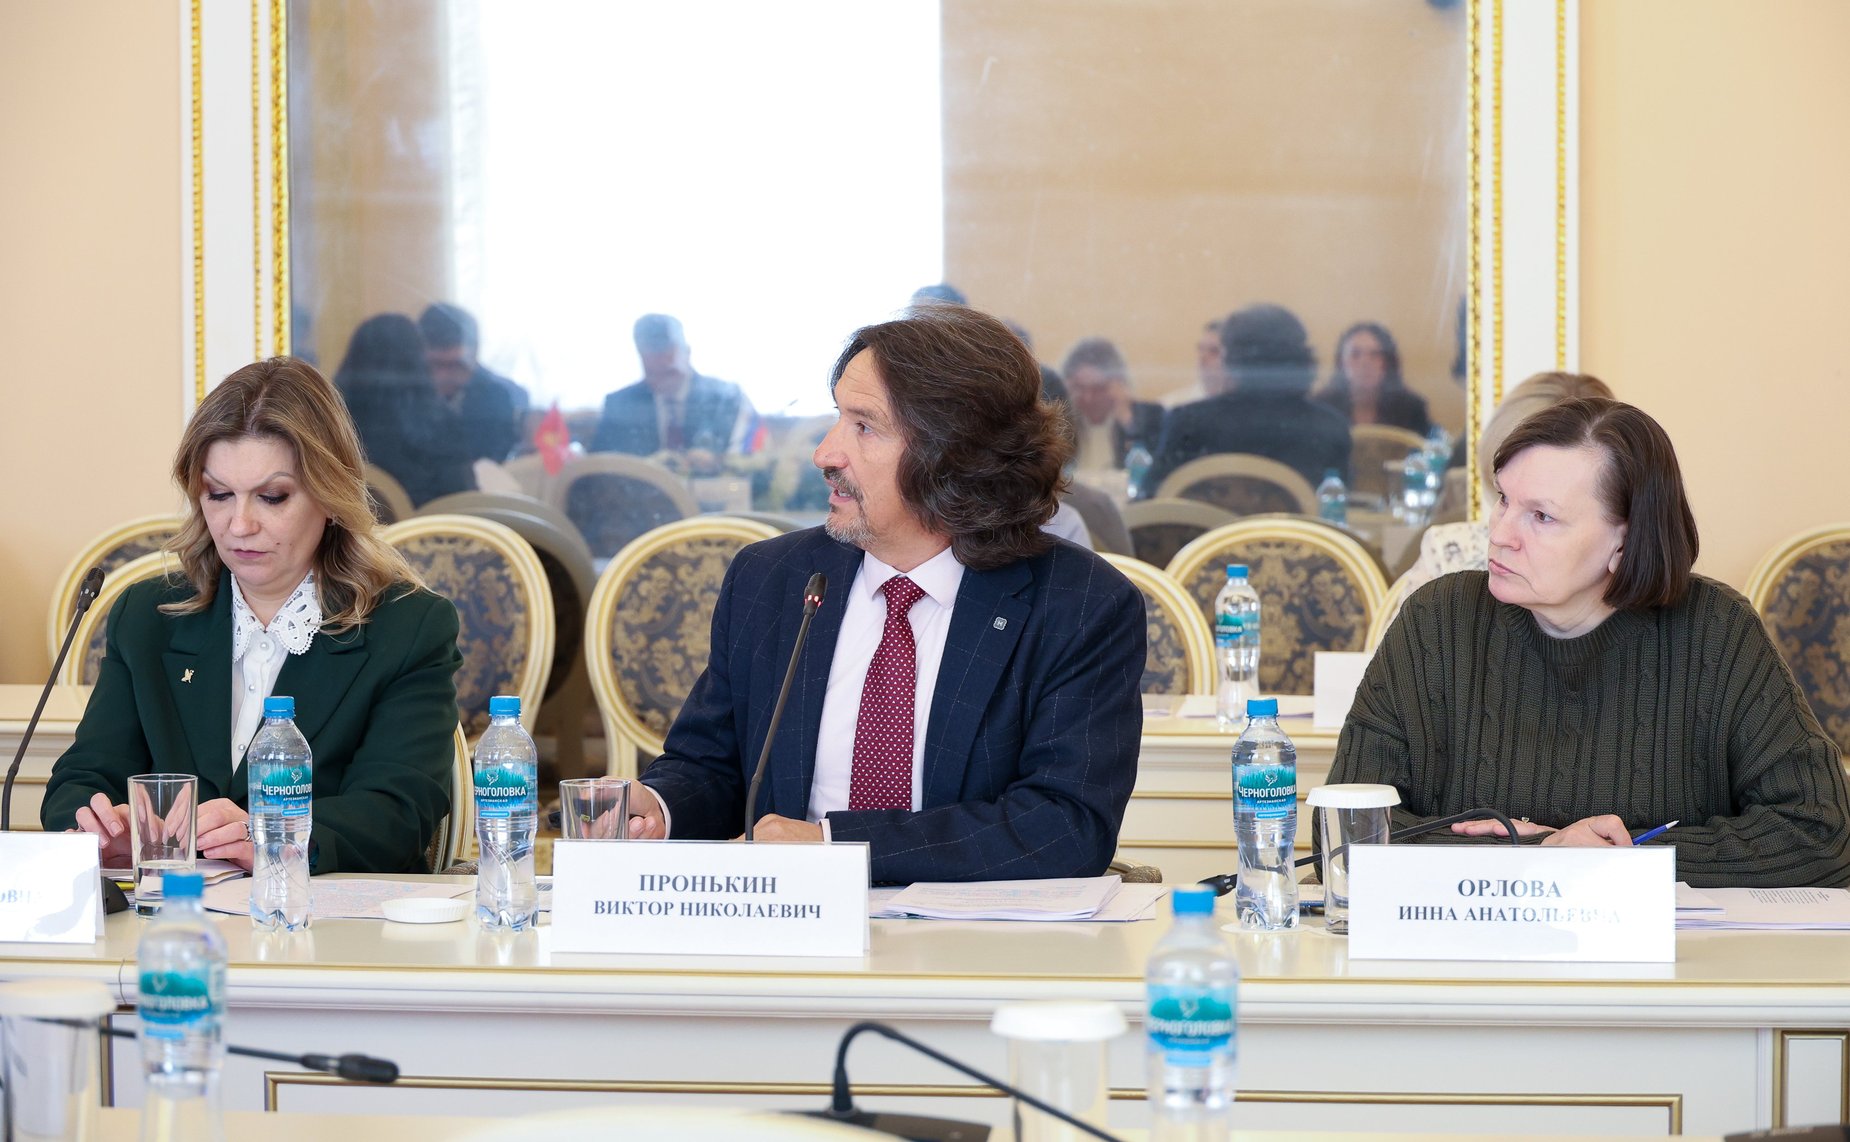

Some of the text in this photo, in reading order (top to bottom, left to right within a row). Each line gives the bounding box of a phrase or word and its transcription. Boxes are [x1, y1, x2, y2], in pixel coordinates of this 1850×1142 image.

[639, 874, 777, 894] ПРОНЬКИН
[1457, 879, 1563, 898] ОРЛОВА
[594, 900, 822, 919] ВИКТОР НИКОЛАЕВИЧ
[1399, 906, 1459, 922] ИННА
